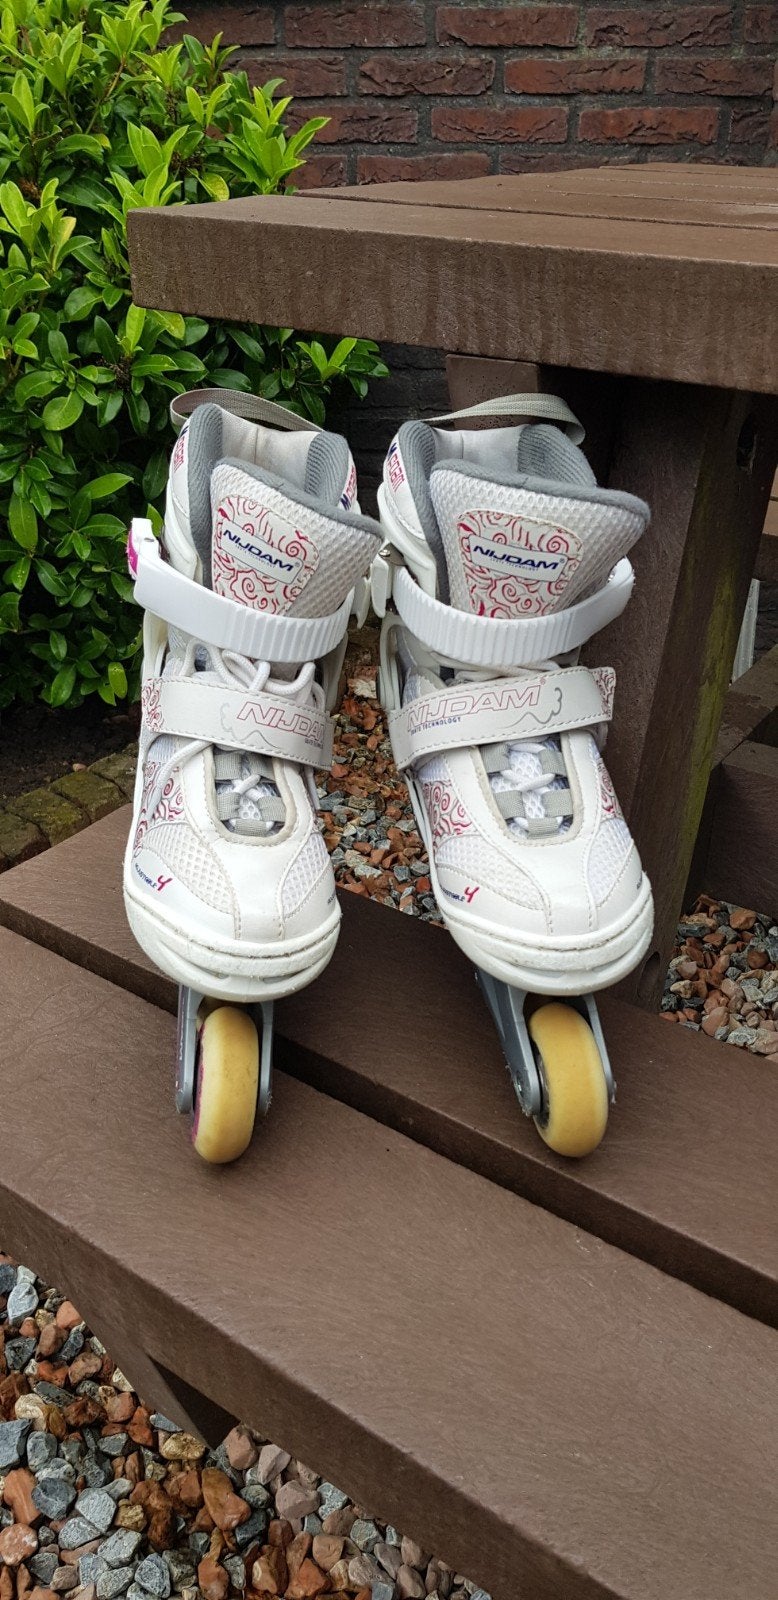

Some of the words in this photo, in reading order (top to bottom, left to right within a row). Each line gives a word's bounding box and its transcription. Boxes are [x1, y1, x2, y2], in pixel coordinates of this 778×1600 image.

[223, 529, 294, 572] NIJDAM
[473, 545, 560, 570] NIJDAM
[407, 684, 541, 732] NIJDAM
[157, 875, 173, 891] 4
[464, 886, 480, 903] 4
